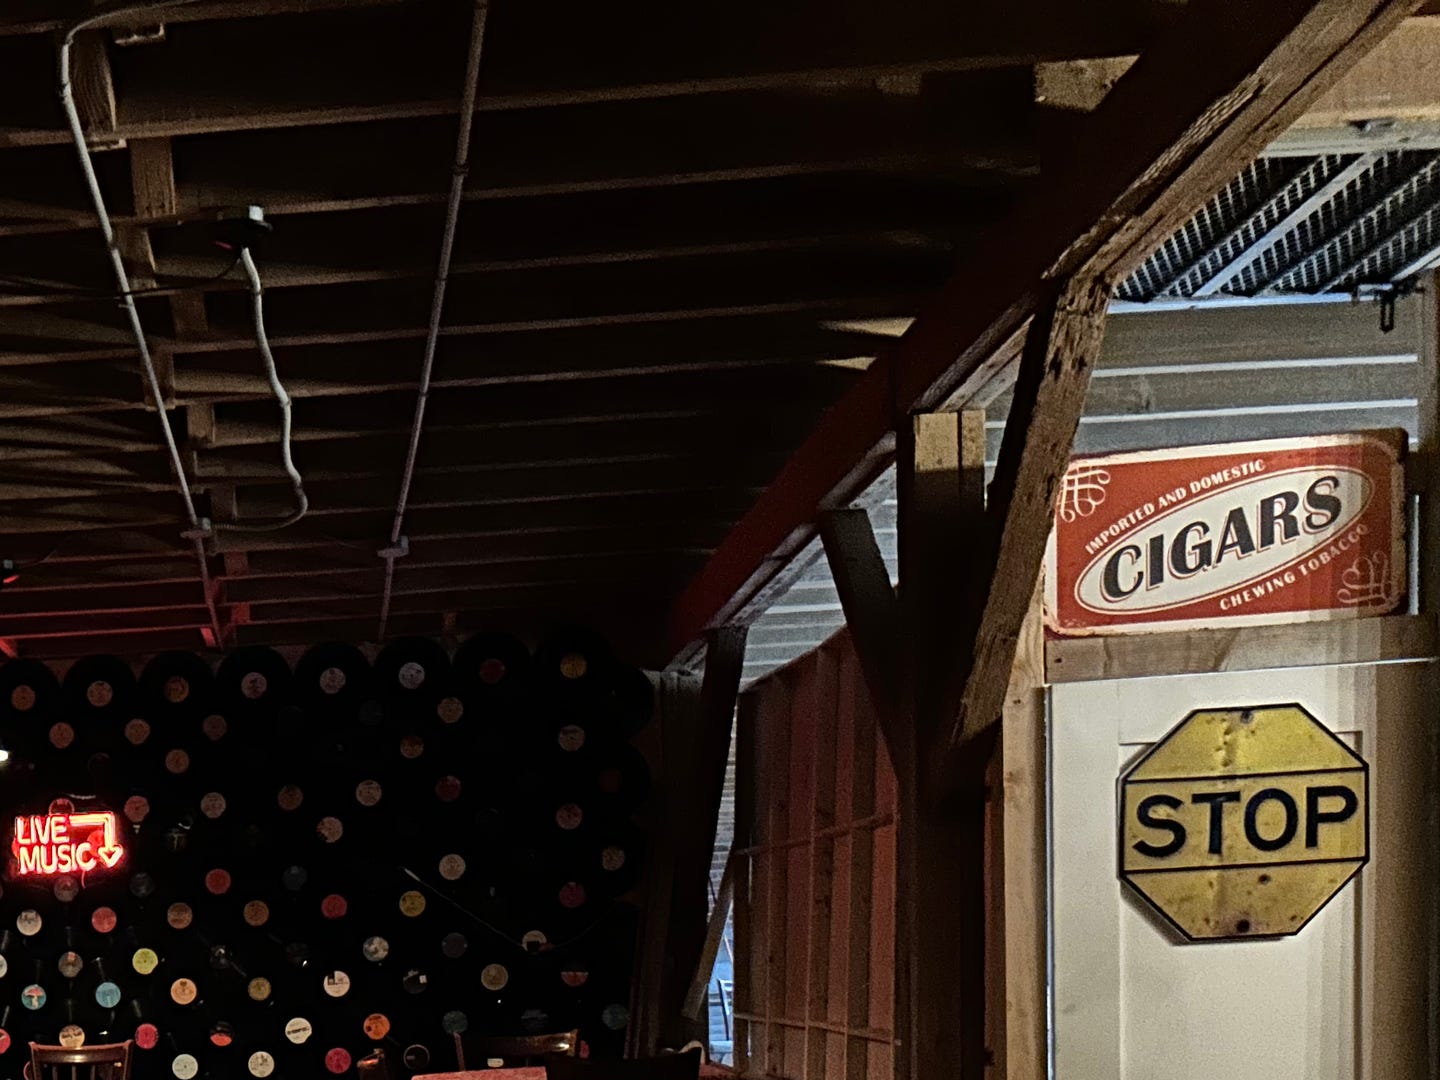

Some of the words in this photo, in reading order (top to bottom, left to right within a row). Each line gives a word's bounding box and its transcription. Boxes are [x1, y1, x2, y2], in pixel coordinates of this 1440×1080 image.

[1085, 503, 1155, 554] IMPORTED
[1158, 487, 1187, 508] AND
[1190, 459, 1266, 494] DOMESTIC
[1099, 475, 1342, 601] CIGARS
[1220, 571, 1295, 611] CHEWING
[1298, 523, 1369, 576] TOBACCO
[15, 814, 70, 844] LIVE
[18, 842, 97, 875] MUSIC
[1132, 785, 1358, 858] STOP
